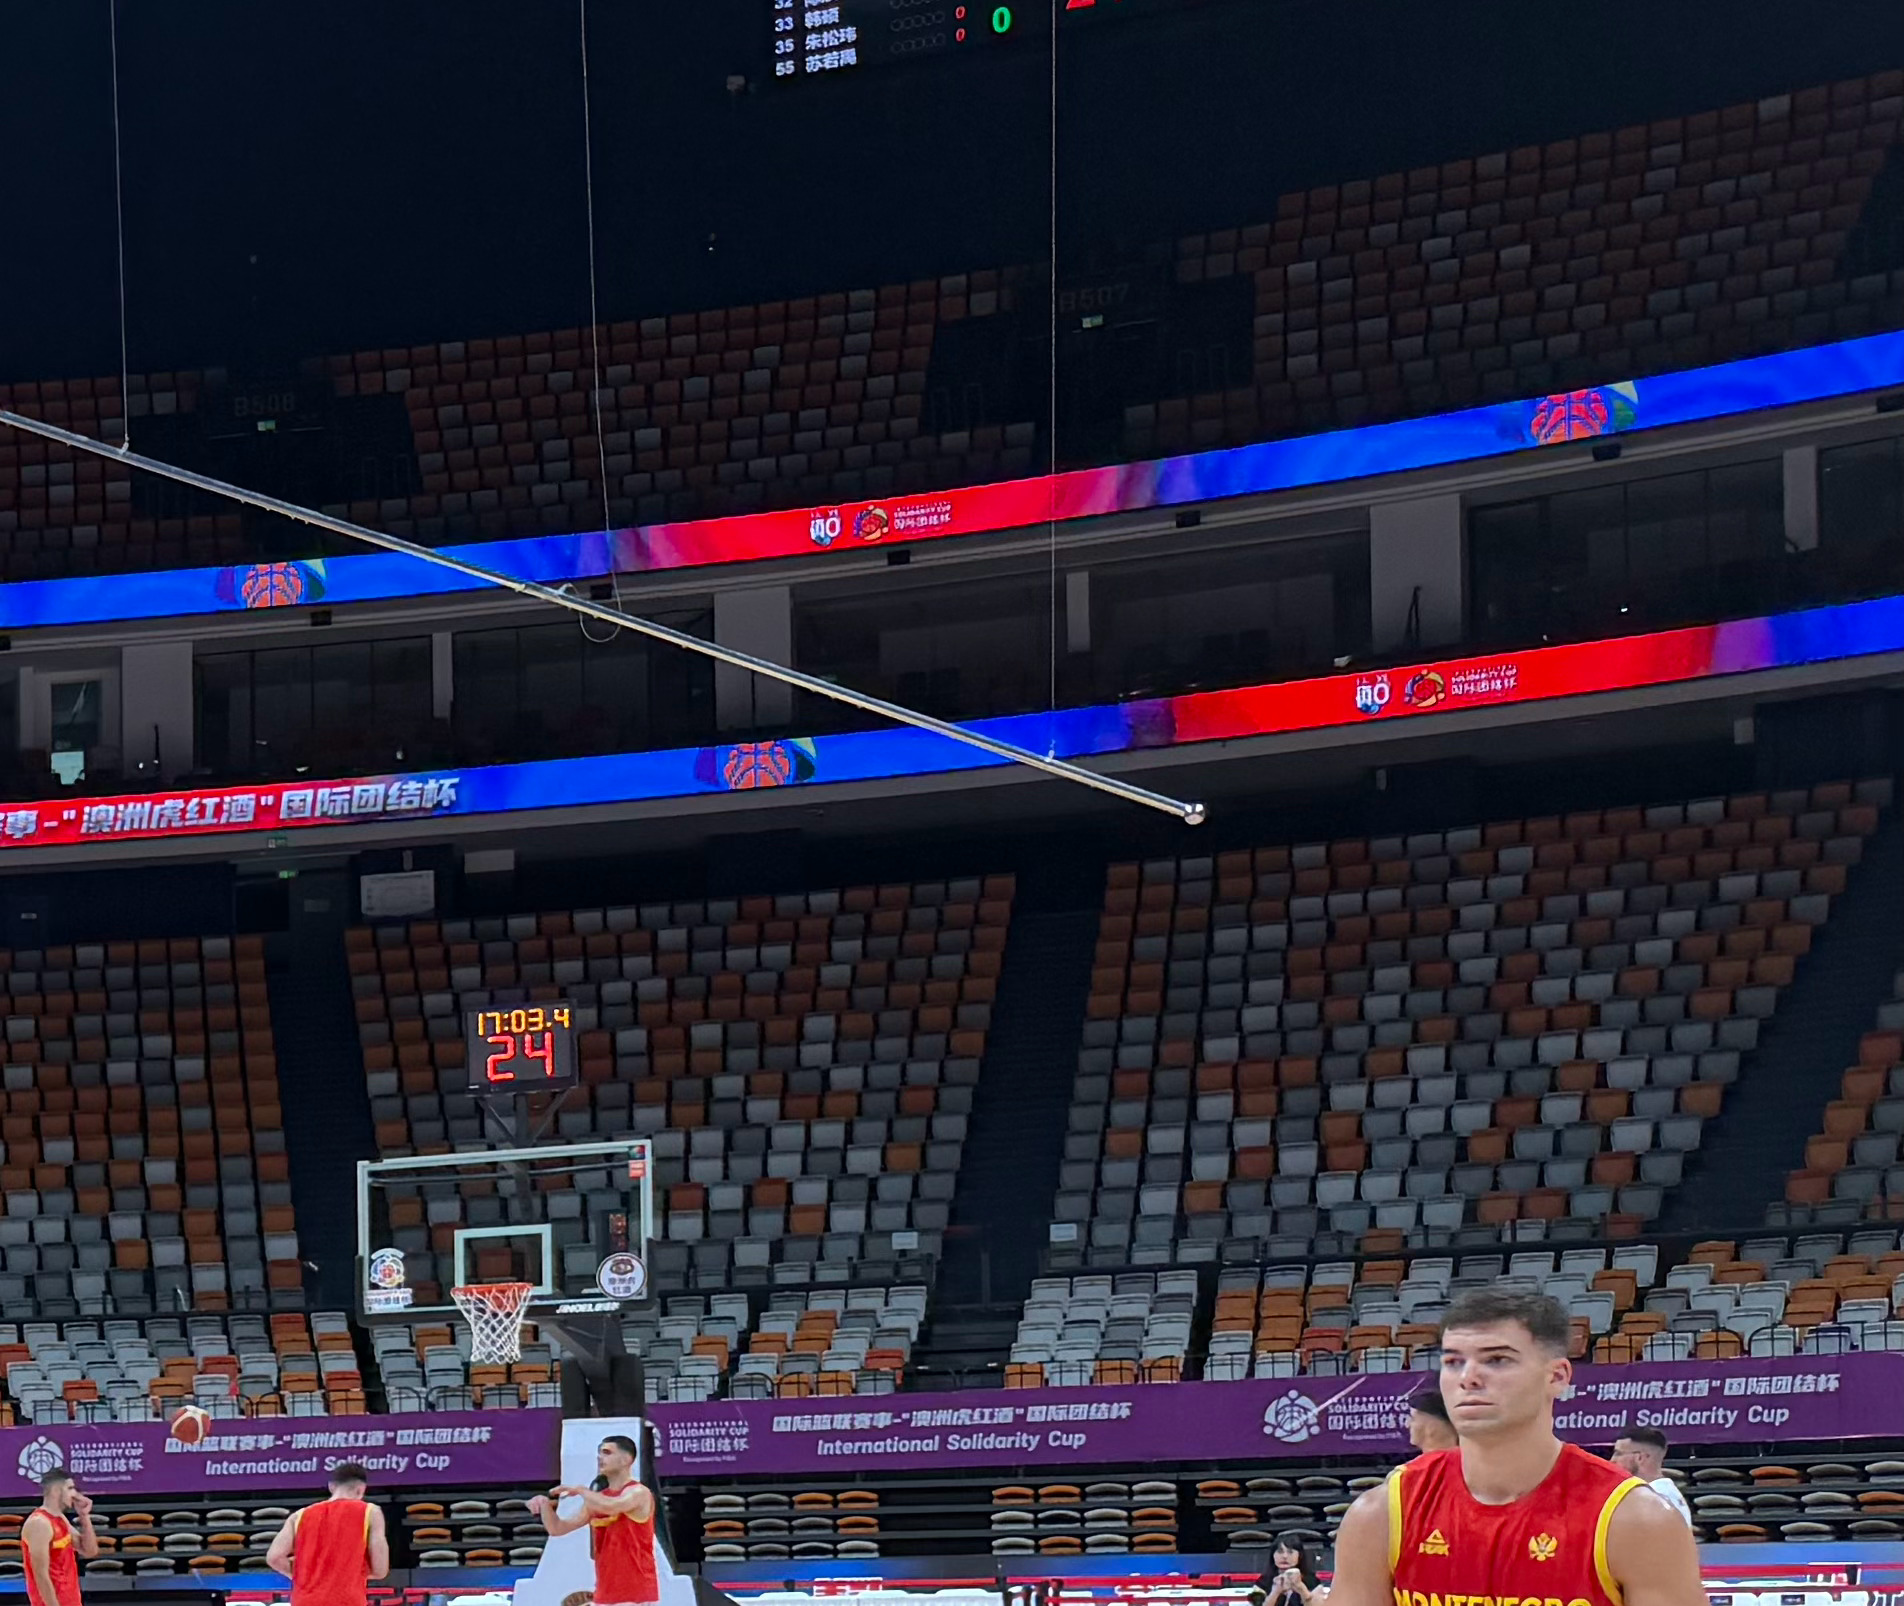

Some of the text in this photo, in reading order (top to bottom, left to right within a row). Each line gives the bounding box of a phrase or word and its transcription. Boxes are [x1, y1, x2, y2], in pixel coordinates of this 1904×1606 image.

[775, 17, 794, 32] 33
[992, 6, 1011, 33] 0
[775, 38, 794, 54] 35
[775, 60, 795, 77] 55
[477, 1008, 571, 1036] 17:03.4
[486, 1033, 554, 1082] 24
[1394, 1402, 1409, 1411] CU
[1636, 1407, 1738, 1428] Solidarity
[1748, 1405, 1790, 1426] Cup
[817, 1431, 1086, 1456] International Solidarity Cup
[205, 1457, 317, 1475] International
[416, 1452, 451, 1470] Cup
